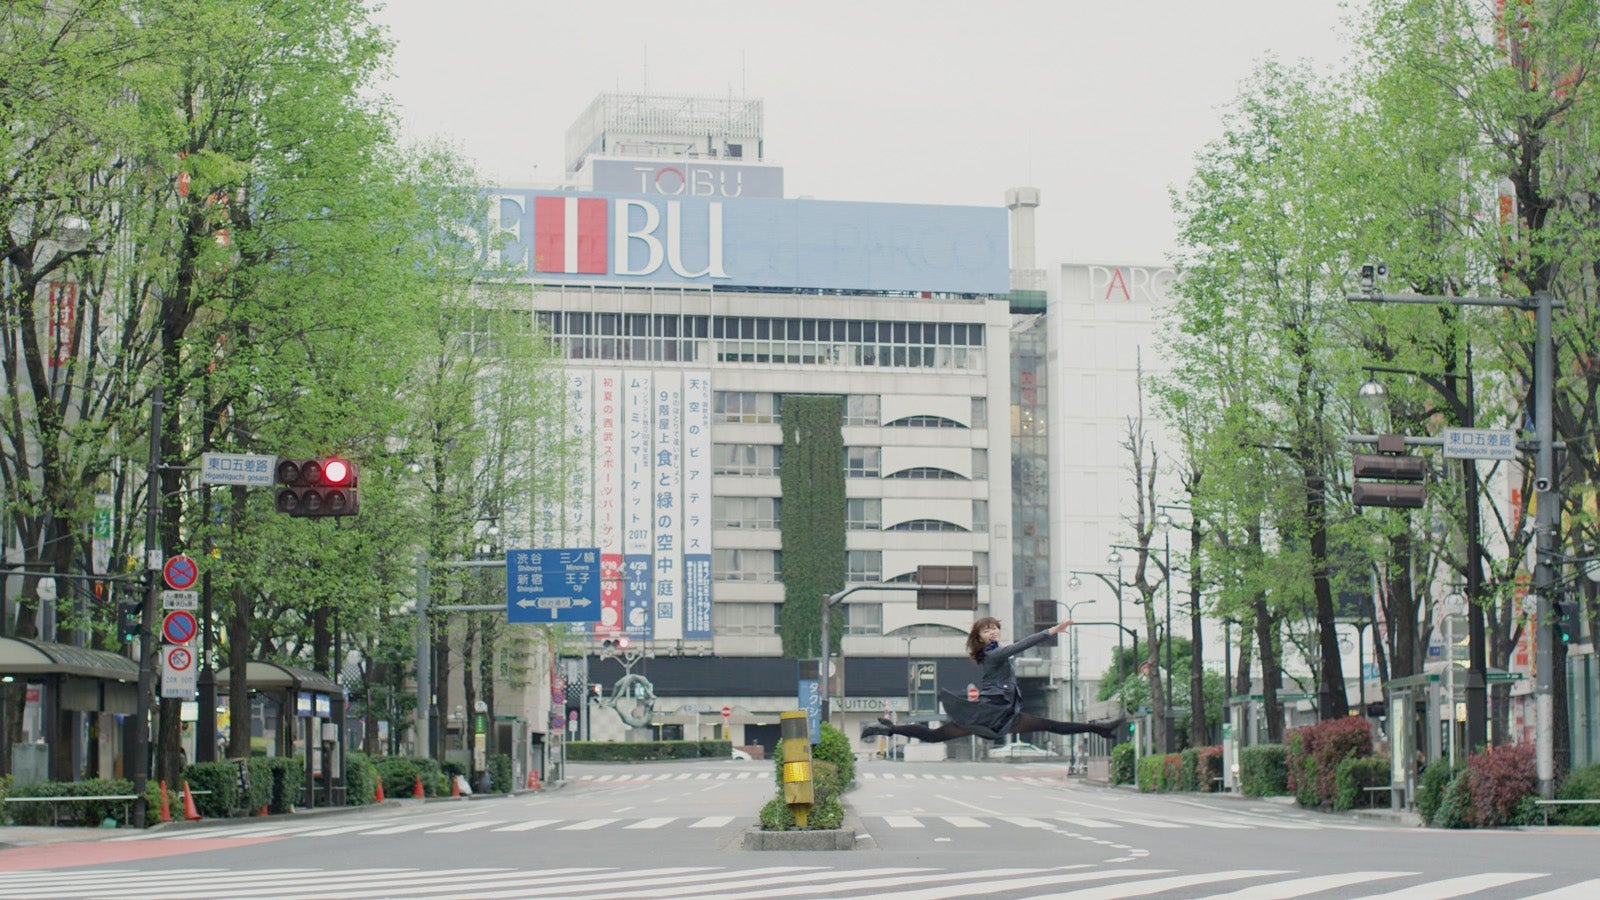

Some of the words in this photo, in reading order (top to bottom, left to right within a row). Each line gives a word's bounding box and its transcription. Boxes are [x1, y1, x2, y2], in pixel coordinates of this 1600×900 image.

[634, 166, 742, 197] TOBU
[435, 193, 731, 279] SEIBU
[1450, 432, 1511, 447] 東口五差路
[630, 378, 640, 524] ムーミンマーケット
[1447, 446, 1488, 455] Higashiguchi
[1490, 448, 1512, 456] gosaro
[208, 457, 269, 473] 東口五差路
[603, 377, 613, 548] 初夏の西武スポーツバーゲン
[689, 379, 700, 548] 天空のビアテラス
[204, 471, 245, 481] Higashiguchi
[247, 474, 269, 482] gosaro
[629, 529, 648, 540] 2017
[516, 553, 542, 565] 渋谷
[560, 552, 595, 564] 三ノ輪
[517, 574, 543, 585] 新宿
[565, 573, 590, 584] 王子
[516, 585, 544, 593] Shinjuku
[573, 584, 583, 592] Oji
[808, 682, 819, 728] タクシー
